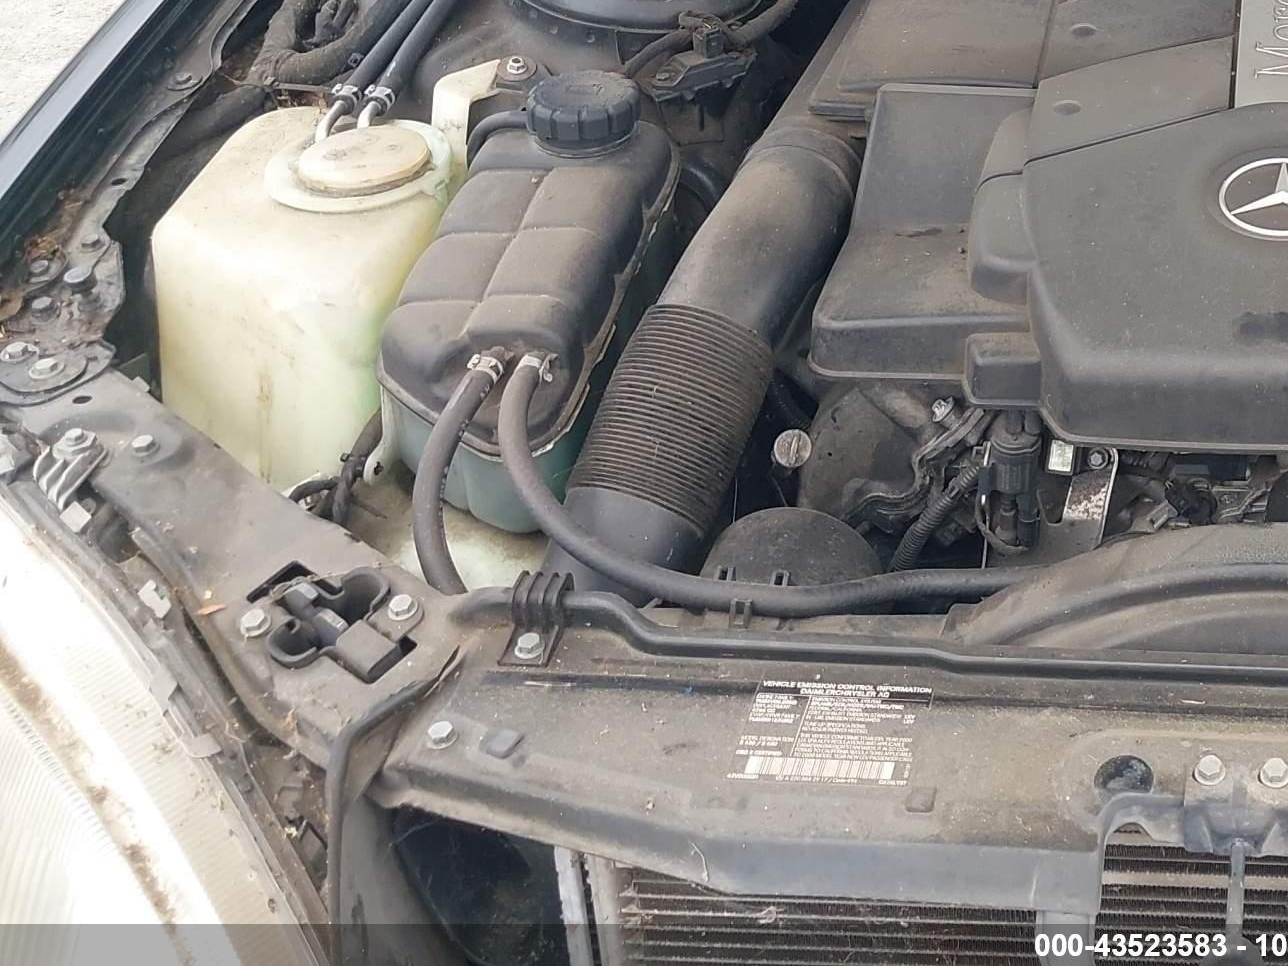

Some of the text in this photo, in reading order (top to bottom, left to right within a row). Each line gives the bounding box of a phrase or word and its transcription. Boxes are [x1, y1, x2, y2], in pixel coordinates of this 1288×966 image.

[763, 680, 796, 688] VEHICLE
[797, 682, 836, 690] EMISSION
[877, 685, 932, 694] INFORMATION
[800, 688, 876, 697] DAIMLERCHRYSLER
